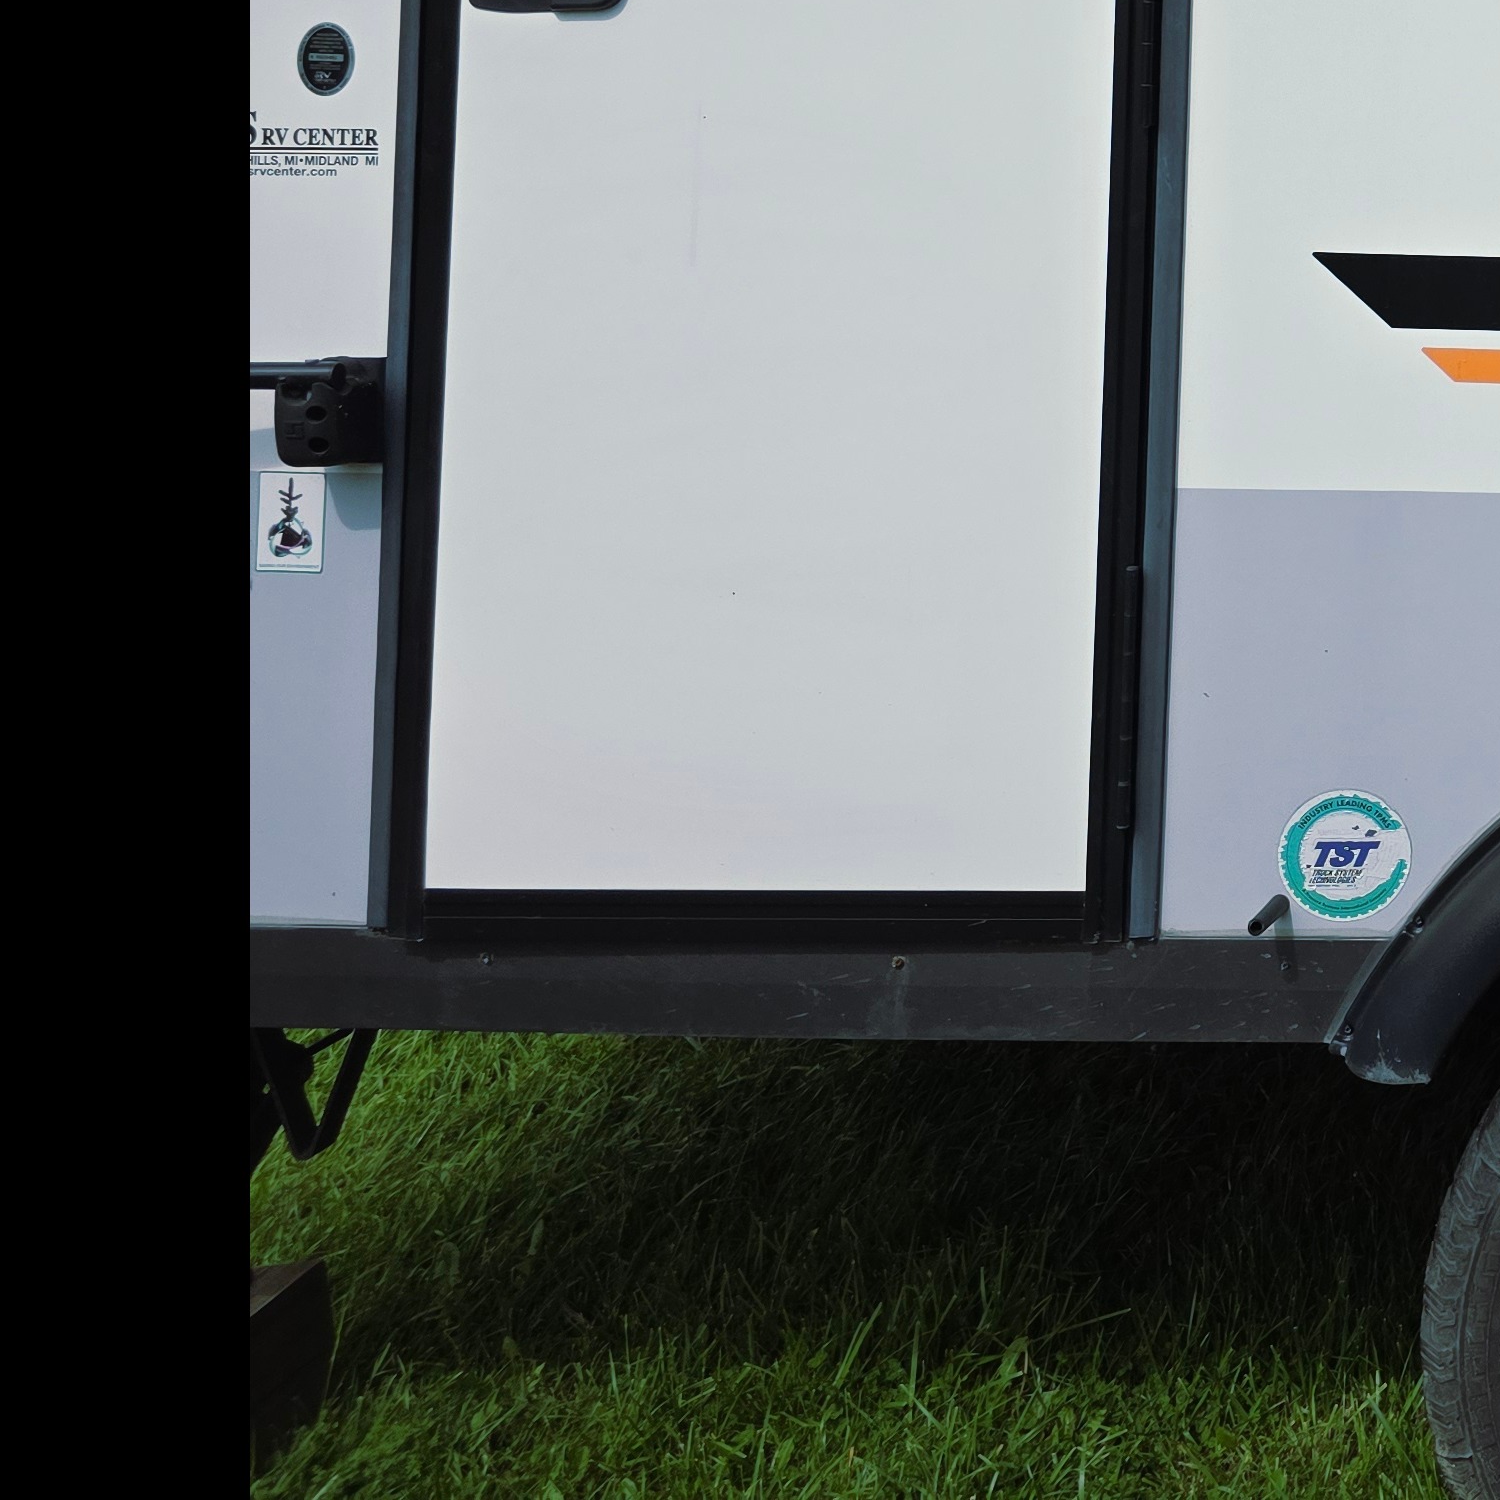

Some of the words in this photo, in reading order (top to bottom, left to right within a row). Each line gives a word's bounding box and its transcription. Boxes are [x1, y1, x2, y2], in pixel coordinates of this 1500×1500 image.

[261, 127, 290, 146] RV
[293, 127, 379, 146] CENTER
[365, 156, 379, 167] MI
[1298, 801, 1334, 830] INDUSTRY
[1336, 799, 1373, 813] LEADING
[1374, 810, 1392, 829] TPMS
[1313, 841, 1381, 868] TST
[1334, 869, 1364, 877] SYSTEM
